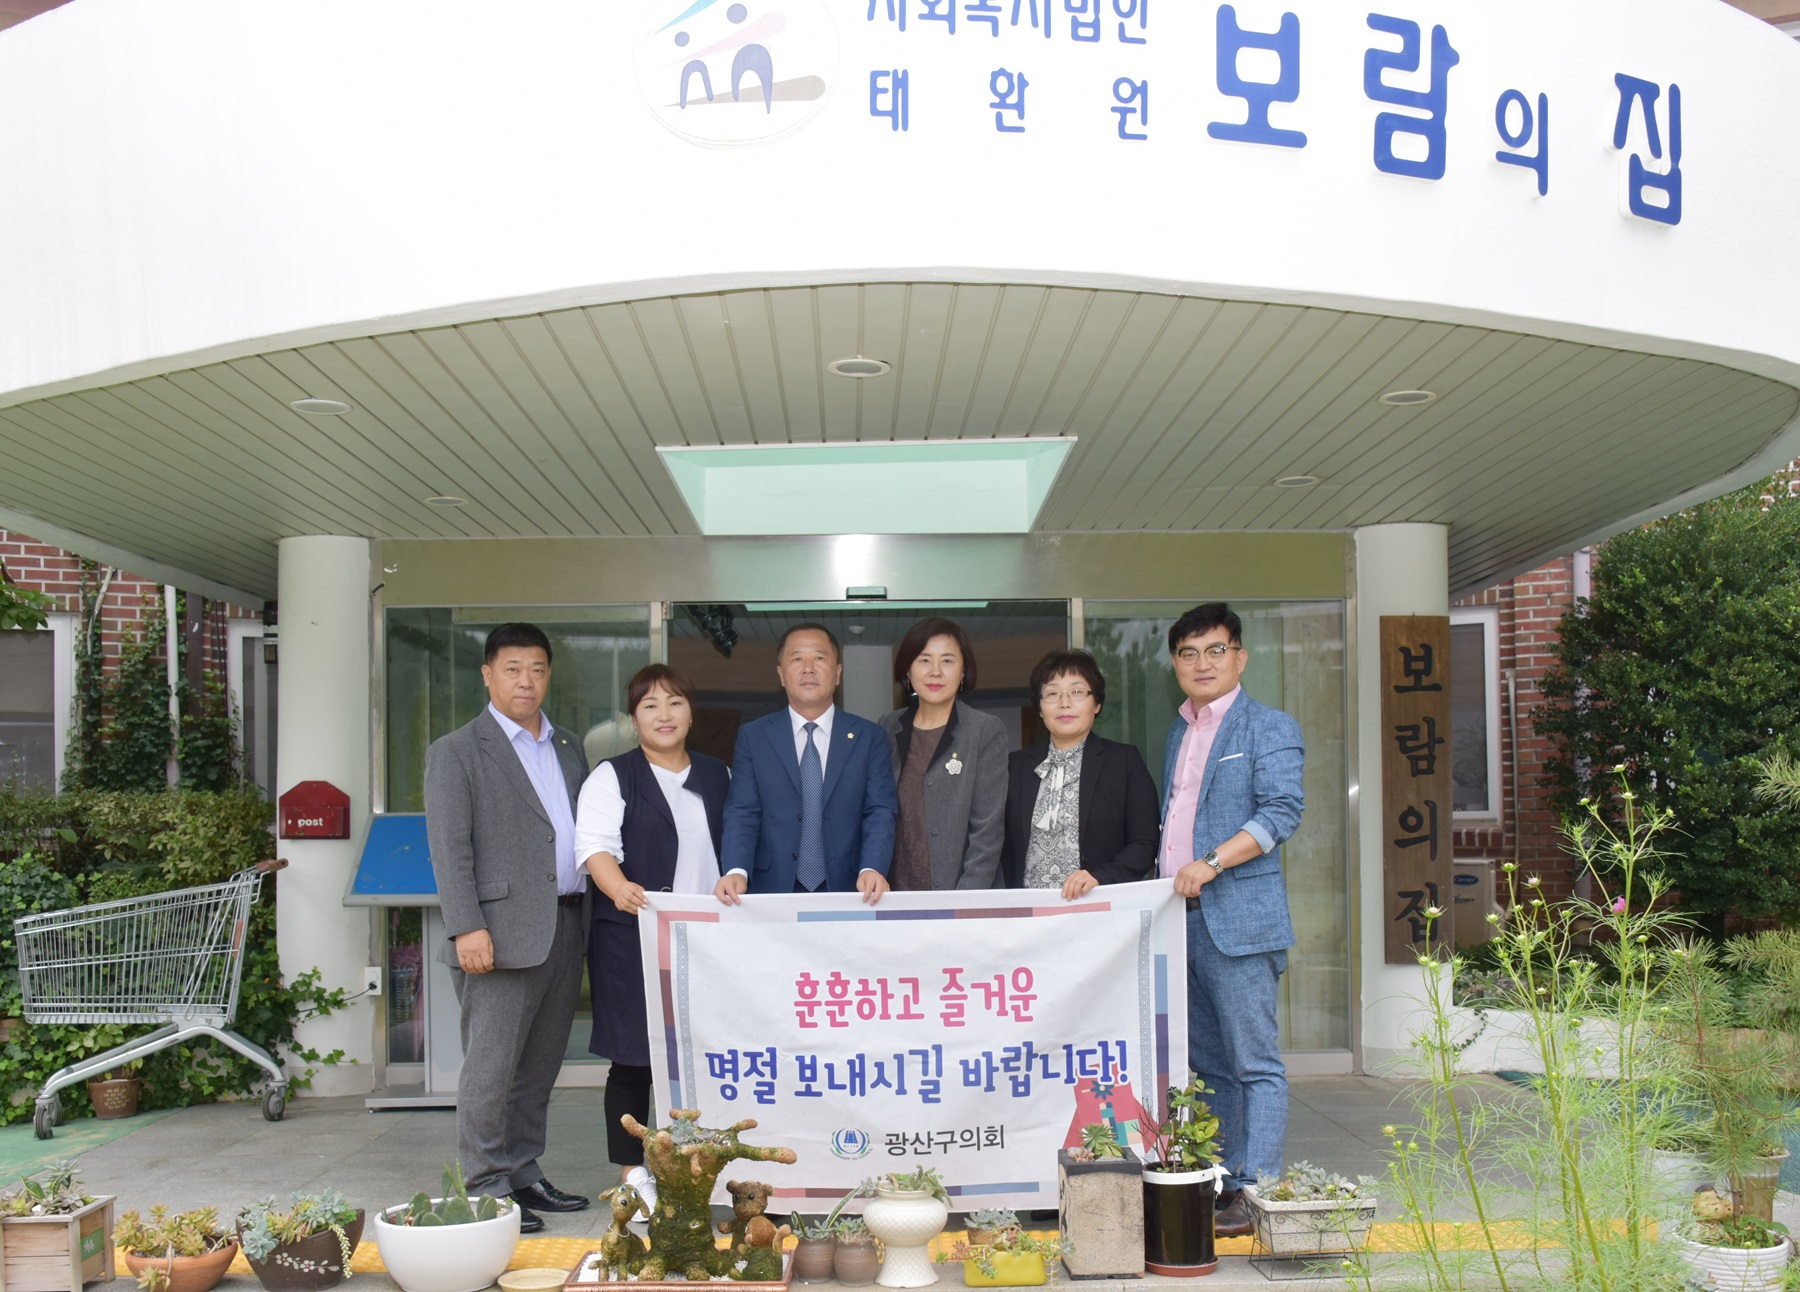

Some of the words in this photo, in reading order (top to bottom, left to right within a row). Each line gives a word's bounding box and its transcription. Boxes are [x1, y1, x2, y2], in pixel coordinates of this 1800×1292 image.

[297, 817, 324, 827] post
[794, 971, 925, 1028] 훈훈하고
[939, 967, 1037, 1027] 즐거운
[705, 1047, 777, 1104] 명절
[794, 1044, 943, 1104] 보내시길
[960, 1040, 1128, 1097] 바랍니다!
[884, 1124, 1004, 1156] 광산구의회
